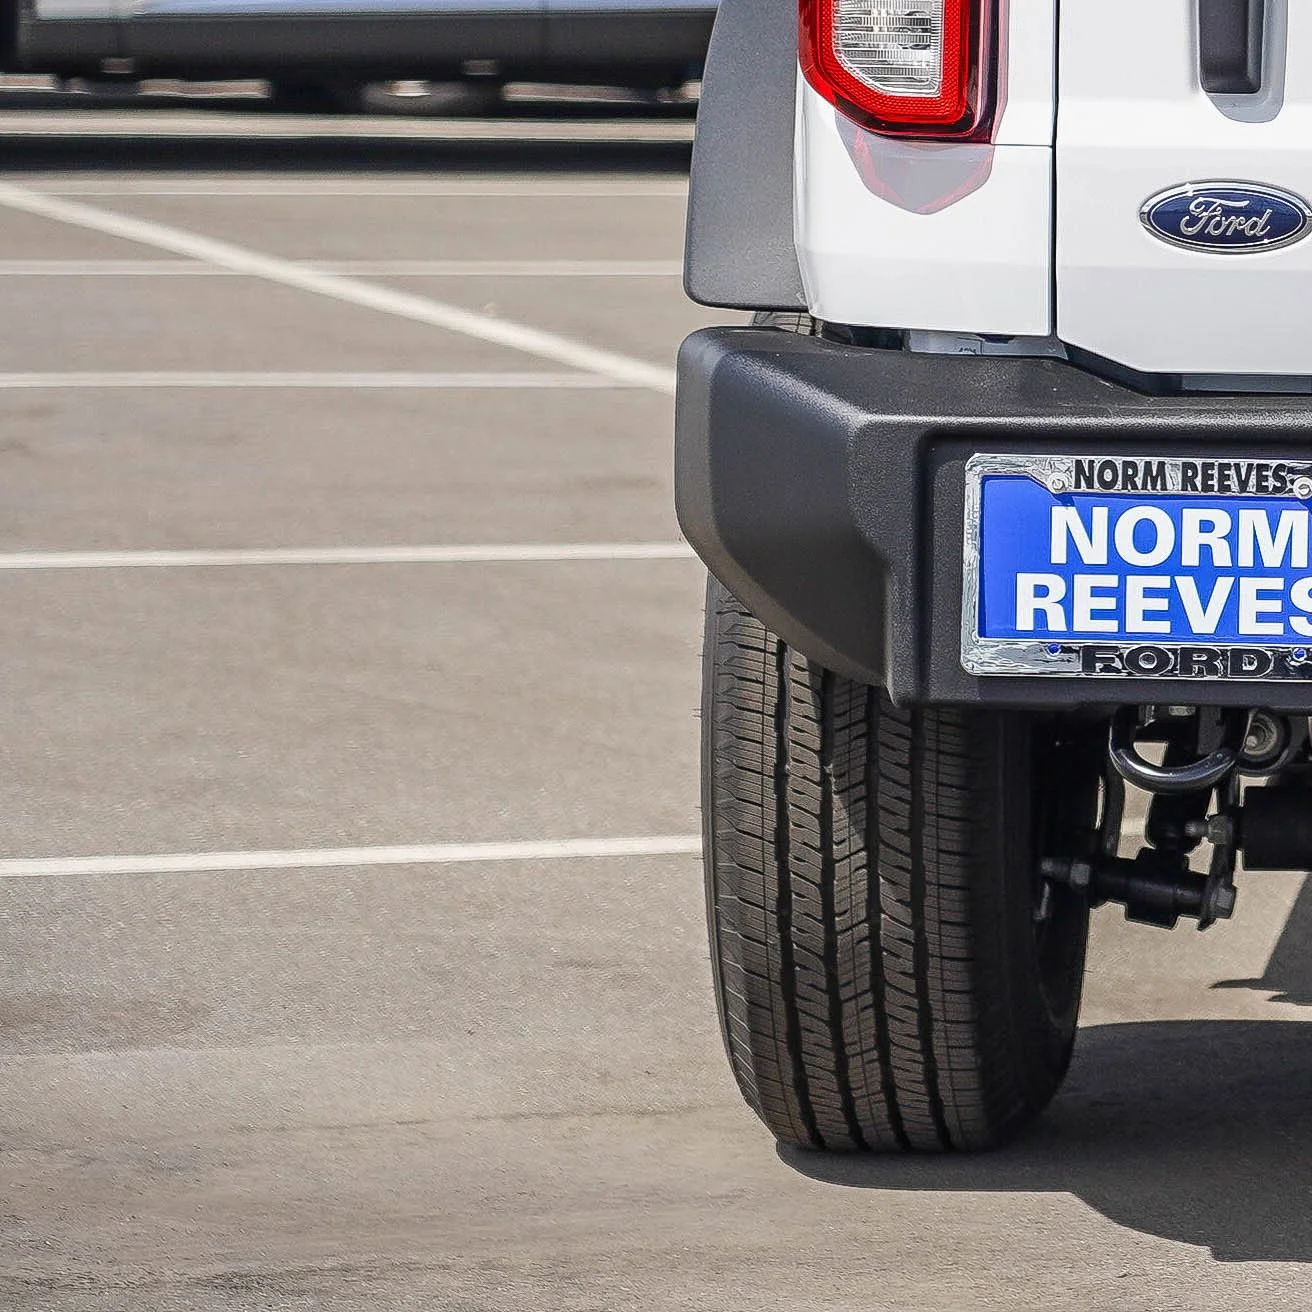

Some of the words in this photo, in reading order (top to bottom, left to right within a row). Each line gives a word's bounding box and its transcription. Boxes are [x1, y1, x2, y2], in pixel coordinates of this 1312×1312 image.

[1180, 196, 1273, 237] Ford
[1073, 459, 1169, 492] NORM
[1182, 461, 1289, 494] REEVES
[1050, 505, 1309, 569] NORM
[1081, 644, 1274, 679] FORD
